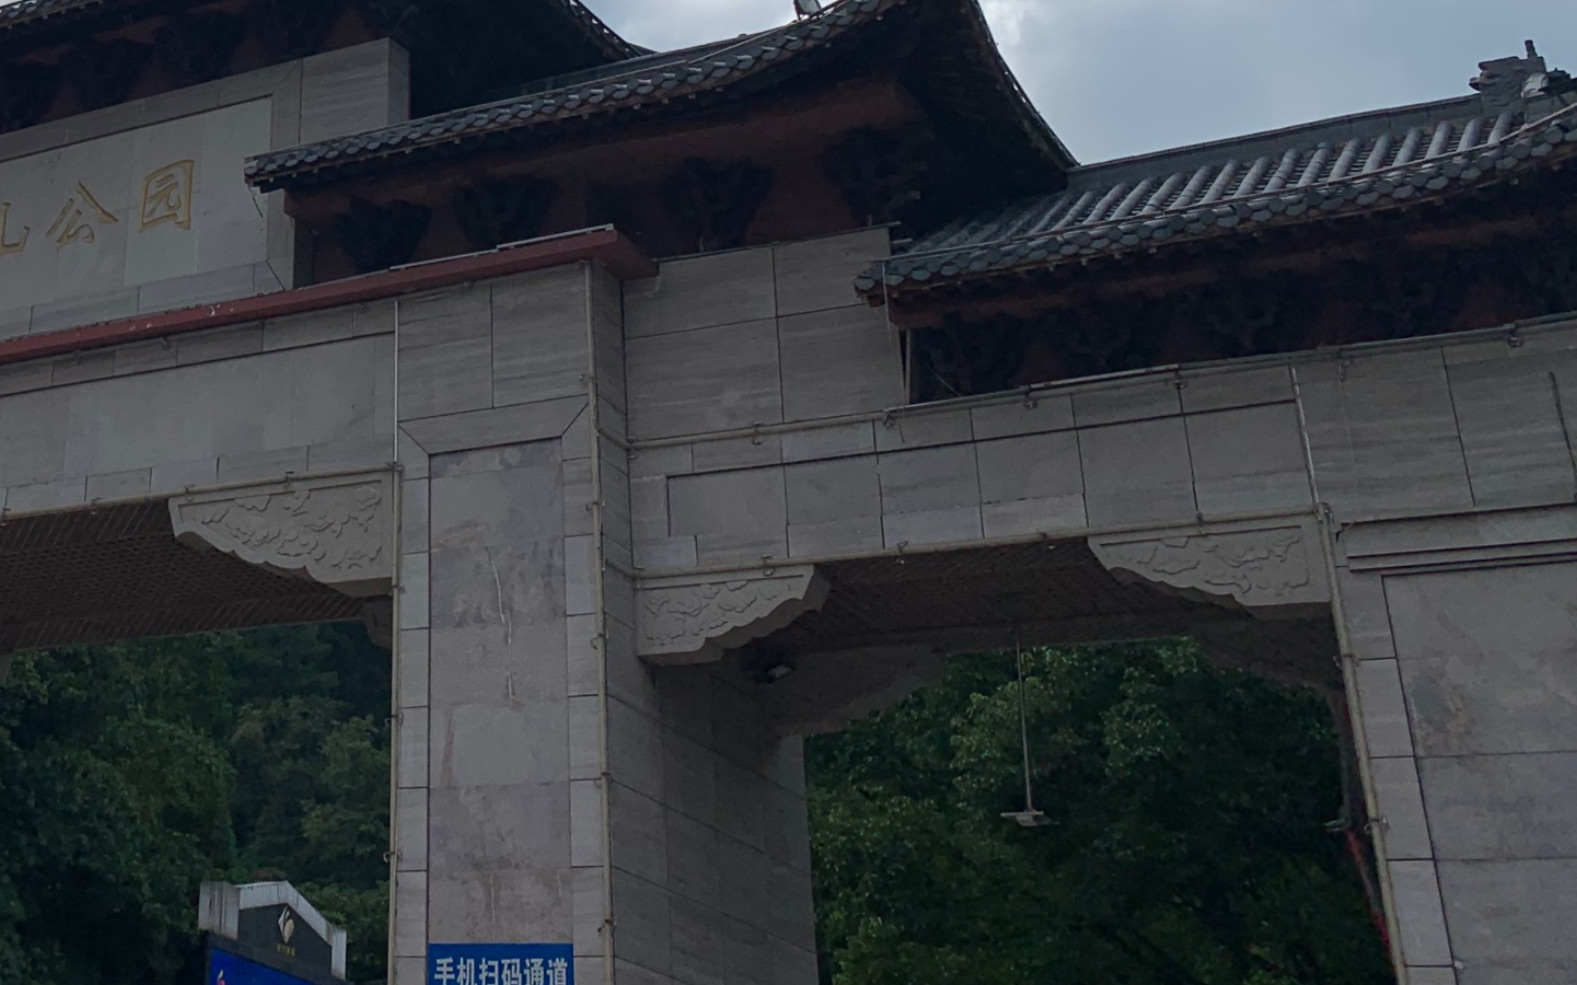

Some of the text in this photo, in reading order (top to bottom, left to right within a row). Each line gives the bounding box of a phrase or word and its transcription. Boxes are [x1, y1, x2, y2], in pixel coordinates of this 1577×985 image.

[434, 957, 568, 985] 手机扫码通道
